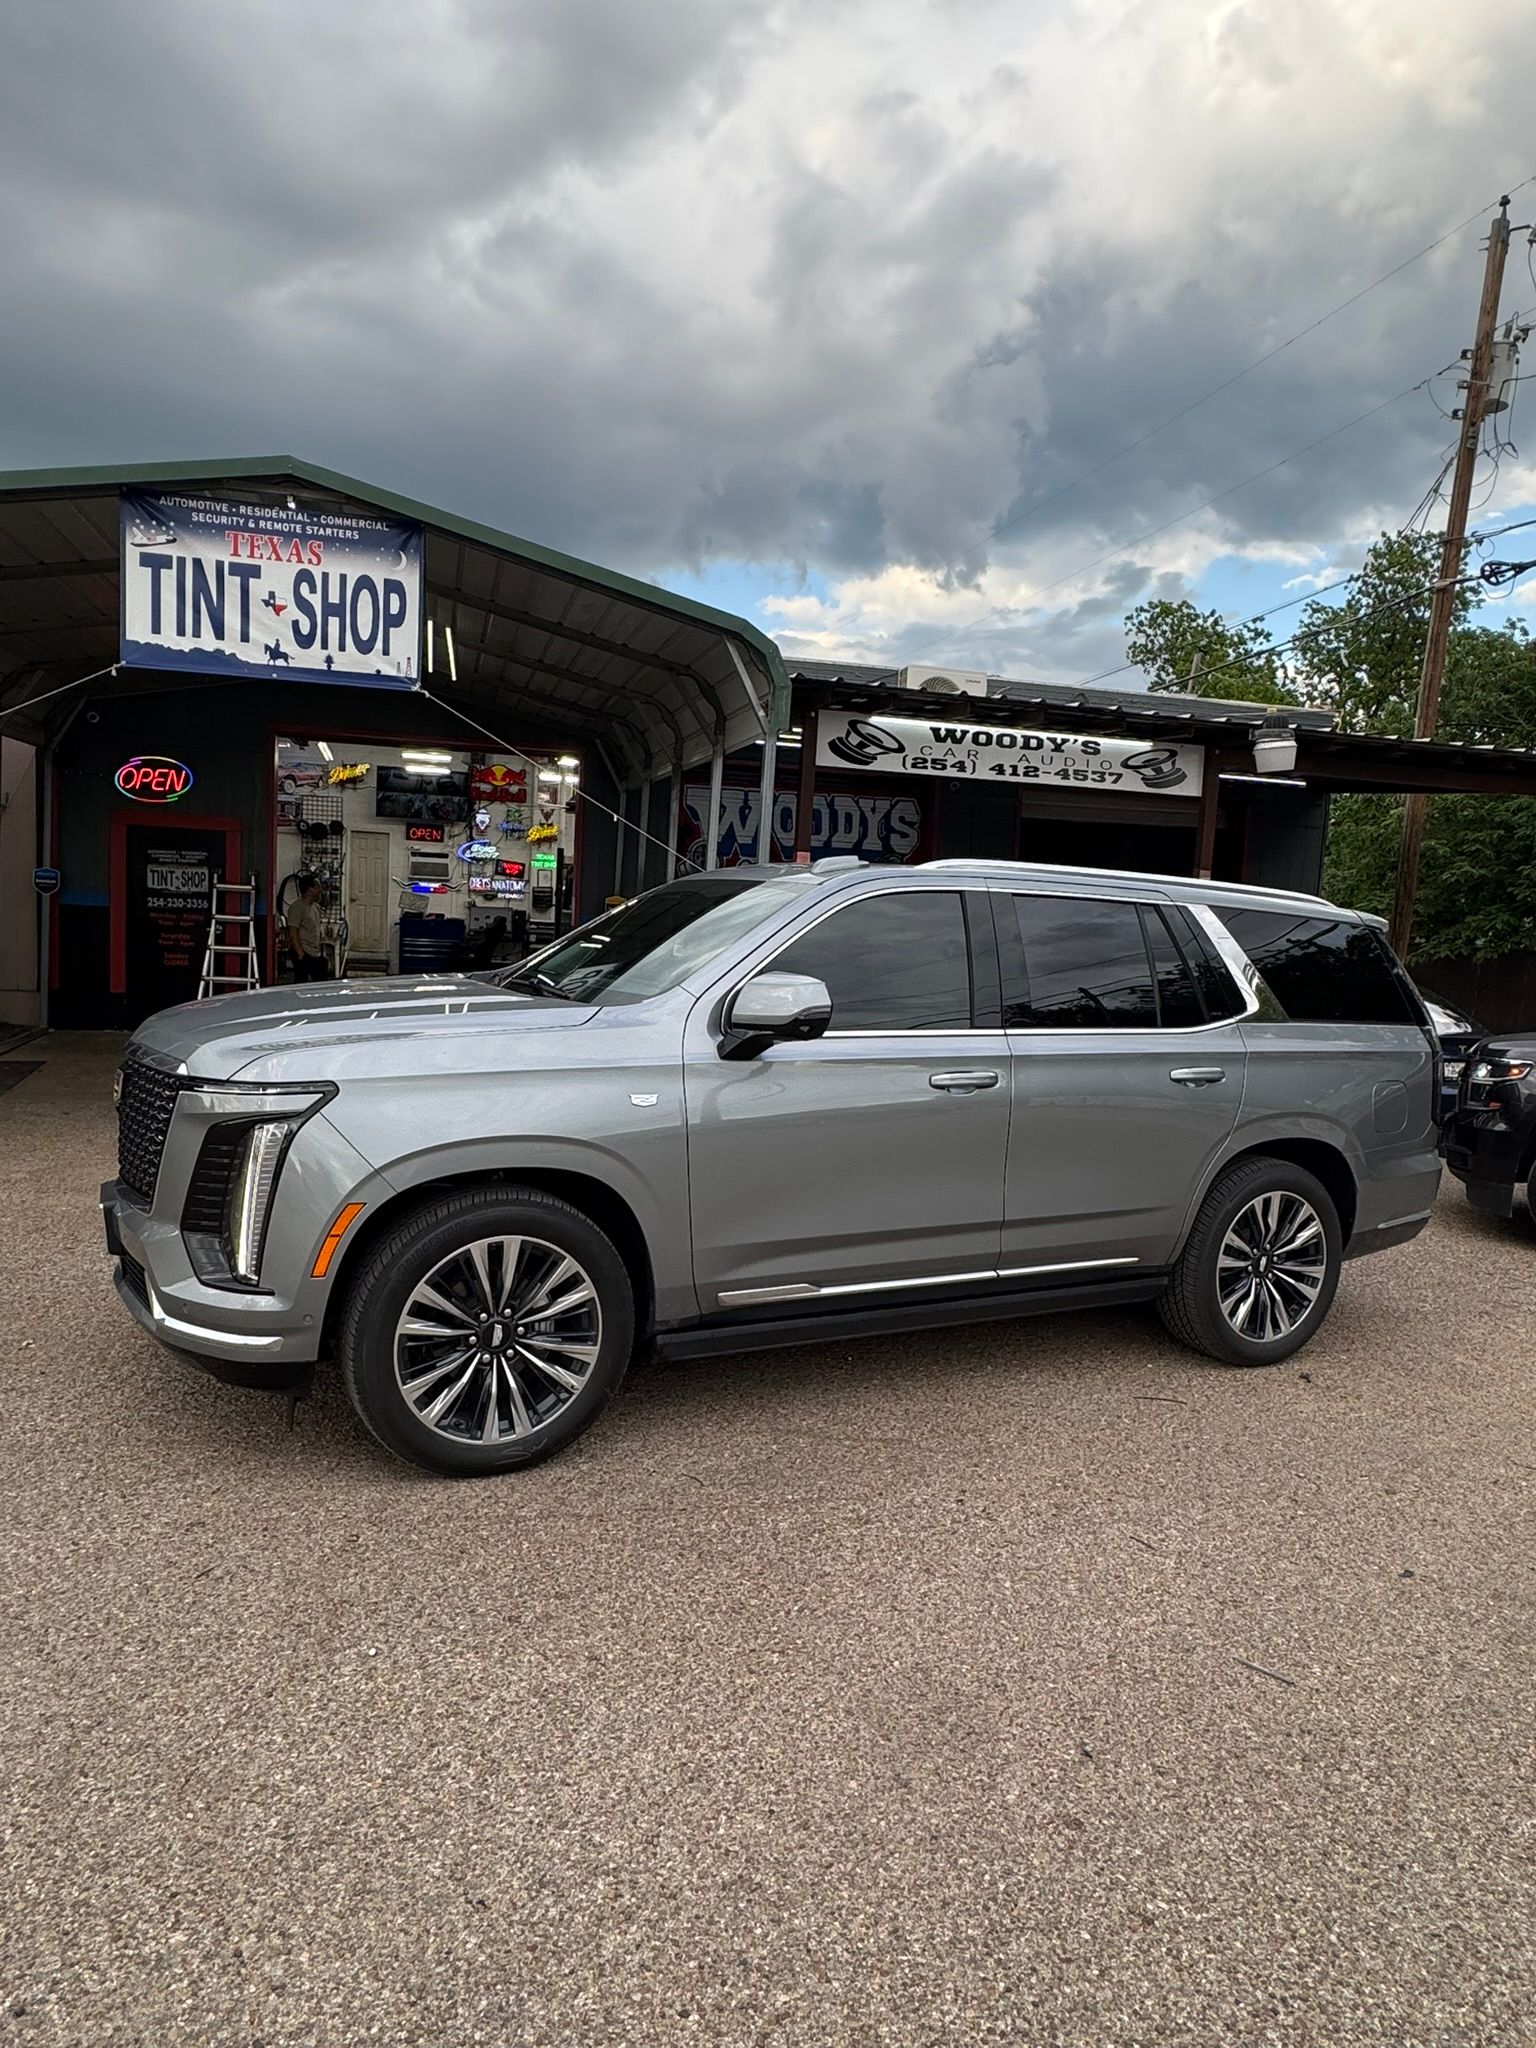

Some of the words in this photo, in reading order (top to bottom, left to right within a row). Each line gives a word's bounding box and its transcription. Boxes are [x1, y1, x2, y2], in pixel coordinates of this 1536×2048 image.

[159, 496, 229, 512] AUTOMOTIVE
[239, 506, 311, 523] RESIDENTIAL
[320, 515, 390, 532] COMMERCIAL
[191, 511, 245, 527] SECURITY
[248, 519, 256, 528] &
[258, 520, 302, 533] REMOTE
[305, 525, 360, 540] STARTERS
[225, 530, 324, 567] TEXAS
[139, 551, 262, 643] TINT
[291, 567, 407, 656] SHOP
[929, 726, 1102, 756] WOODY'S
[902, 753, 977, 775] (254)
[988, 763, 1124, 785] 412-4537
[919, 745, 980, 761] CAR
[1017, 753, 1113, 771] AUDIO
[120, 767, 186, 791] OPEN
[409, 828, 442, 840] OPEN
[149, 869, 176, 887] TINT
[181, 870, 207, 889] SHOP
